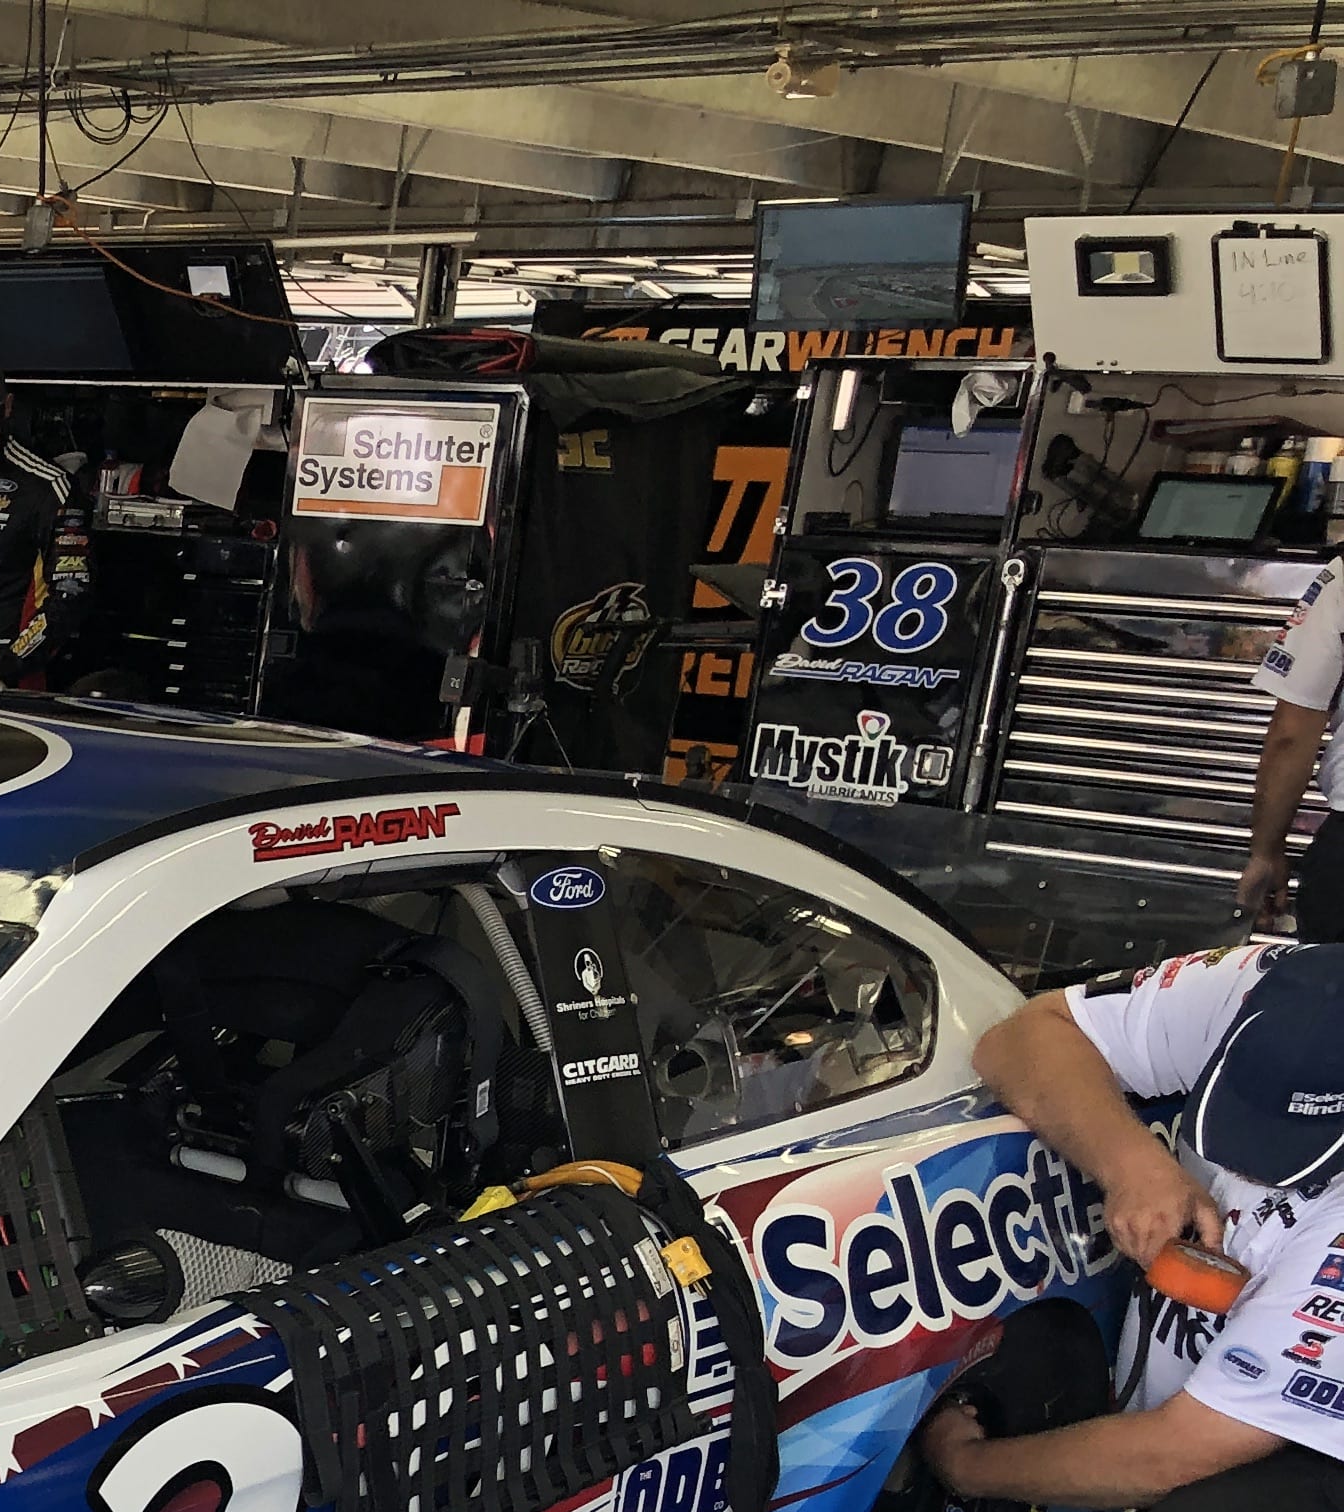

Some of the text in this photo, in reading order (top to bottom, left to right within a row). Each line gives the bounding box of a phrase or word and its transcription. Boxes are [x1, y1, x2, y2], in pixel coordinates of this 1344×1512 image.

[352, 429, 490, 464] Schluter
[298, 459, 433, 494] Systems
[800, 557, 958, 654] 38
[836, 661, 960, 689] RAGAN
[758, 722, 904, 789] Mystik
[332, 803, 461, 849] RAGAN
[549, 872, 595, 902] Ford
[556, 1000, 595, 1014] Shriners
[562, 1053, 640, 1079] CITGARD
[762, 1150, 1080, 1358] Select
[639, 1470, 653, 1482] THE
